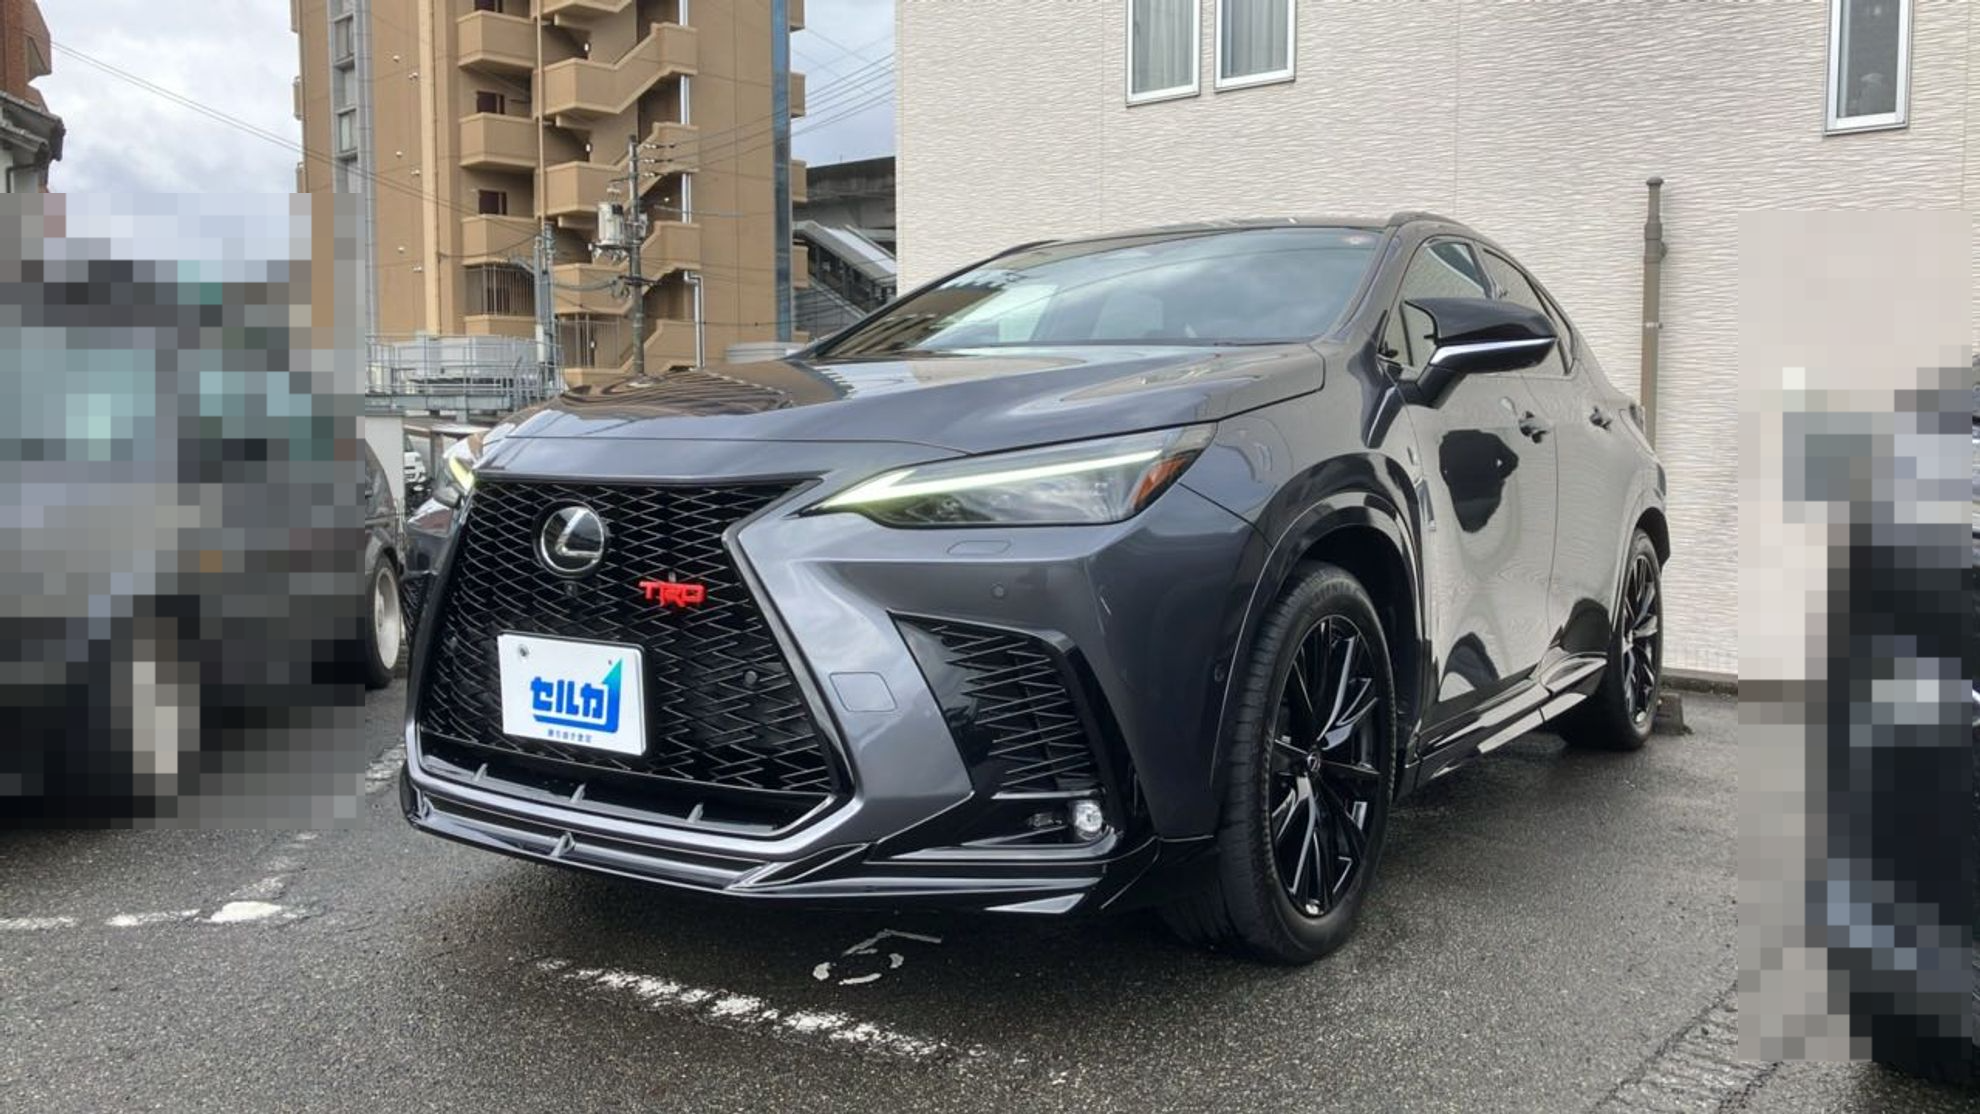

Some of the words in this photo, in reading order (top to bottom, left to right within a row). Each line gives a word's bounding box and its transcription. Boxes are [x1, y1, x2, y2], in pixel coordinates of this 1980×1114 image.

[639, 580, 705, 607] TRD
[530, 676, 605, 720] セルカ
